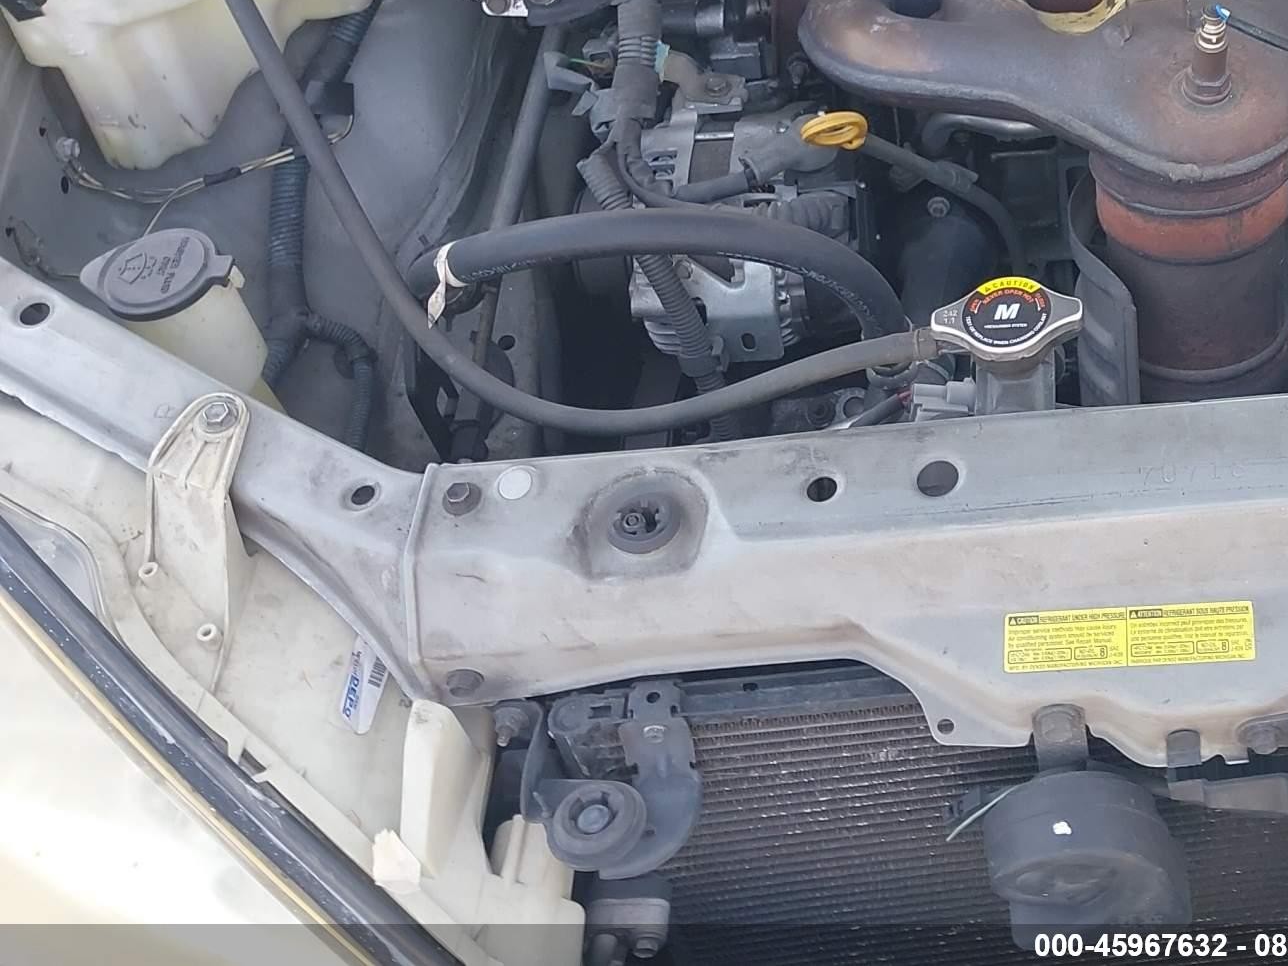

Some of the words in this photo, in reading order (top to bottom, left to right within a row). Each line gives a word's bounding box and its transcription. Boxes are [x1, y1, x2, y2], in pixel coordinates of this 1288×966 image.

[992, 280, 1035, 290] CAUTION
[993, 303, 1020, 320] M
[343, 674, 360, 718] DEPO
